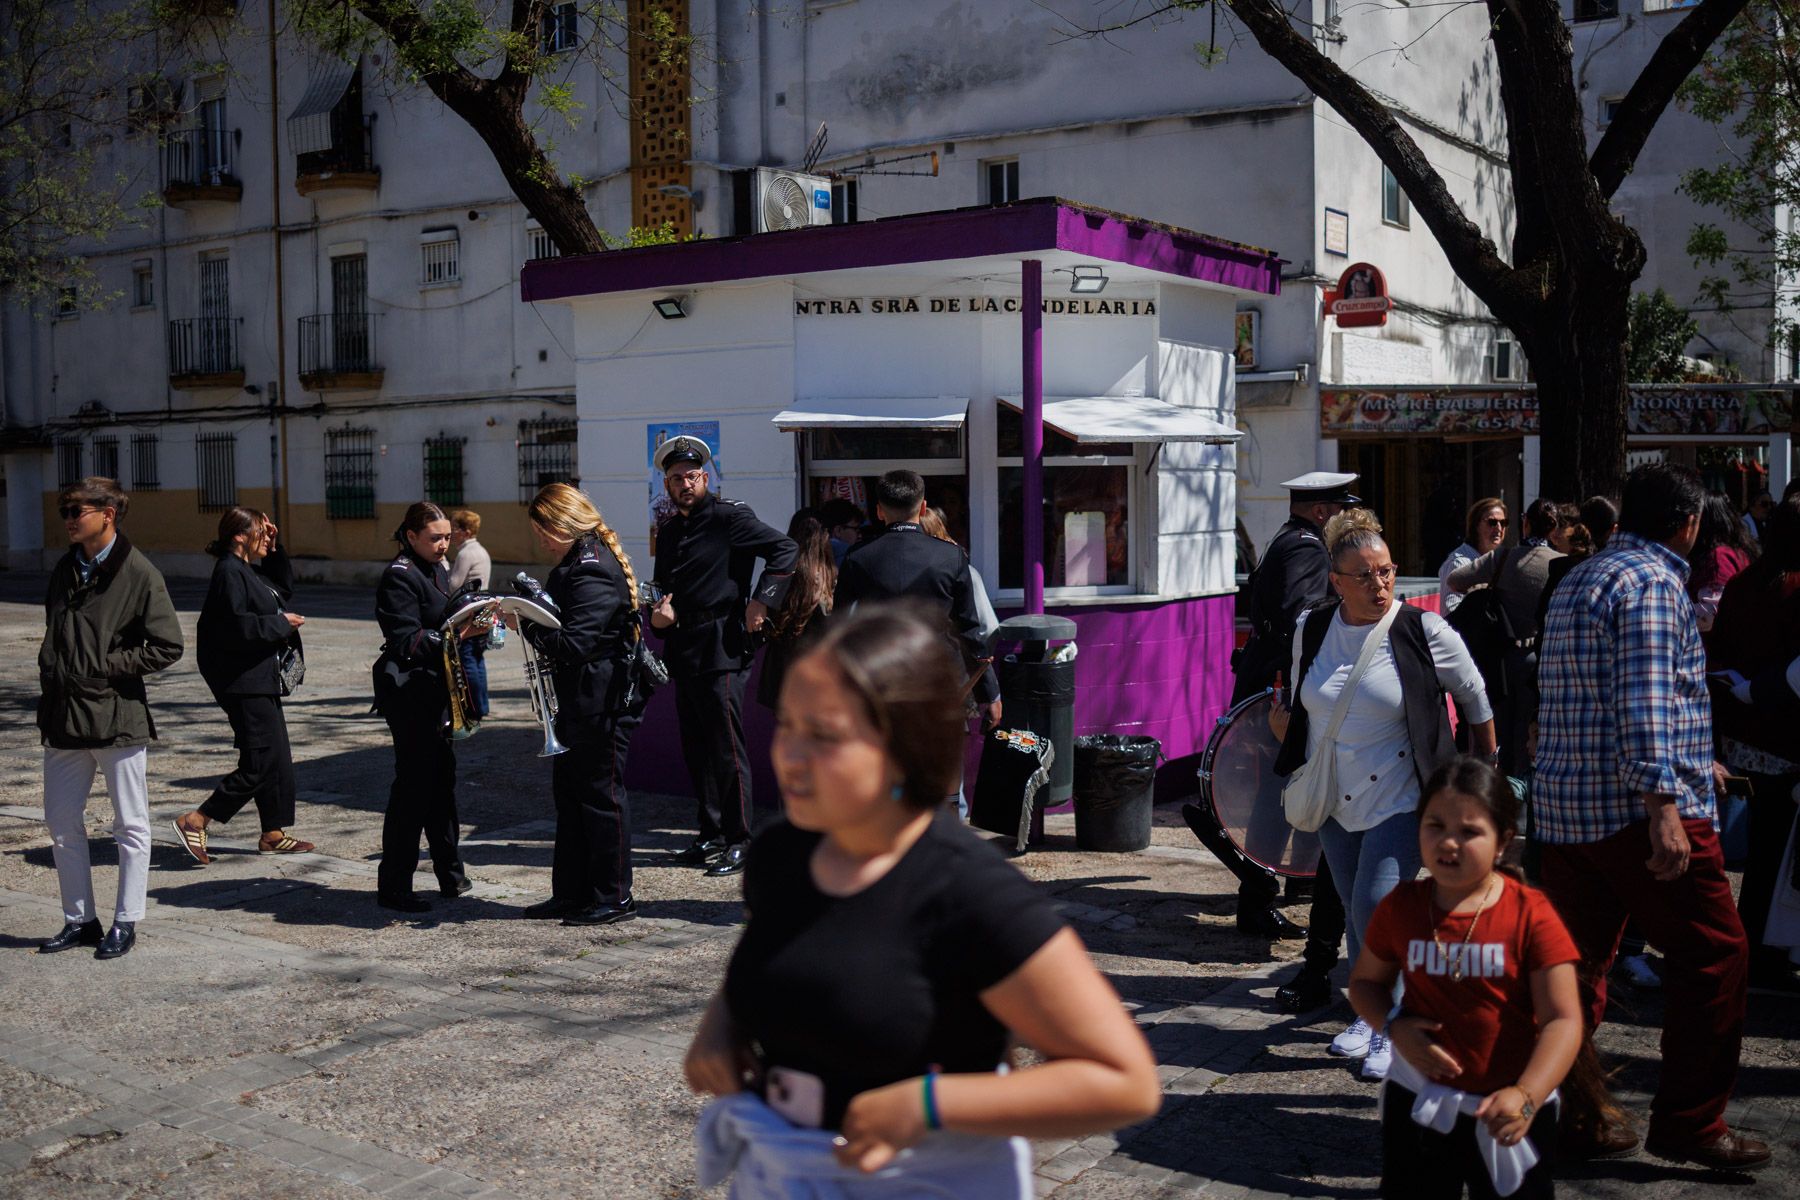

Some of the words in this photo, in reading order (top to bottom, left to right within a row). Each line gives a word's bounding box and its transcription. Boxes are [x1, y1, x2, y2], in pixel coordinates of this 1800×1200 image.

[796, 300, 861, 315] NTRA
[871, 299, 920, 314] SRA
[930, 299, 961, 314] DE
[1409, 398, 1476, 410] KEBAB
[1632, 397, 1742, 409] RONTERA
[1407, 939, 1504, 977] PUMA
